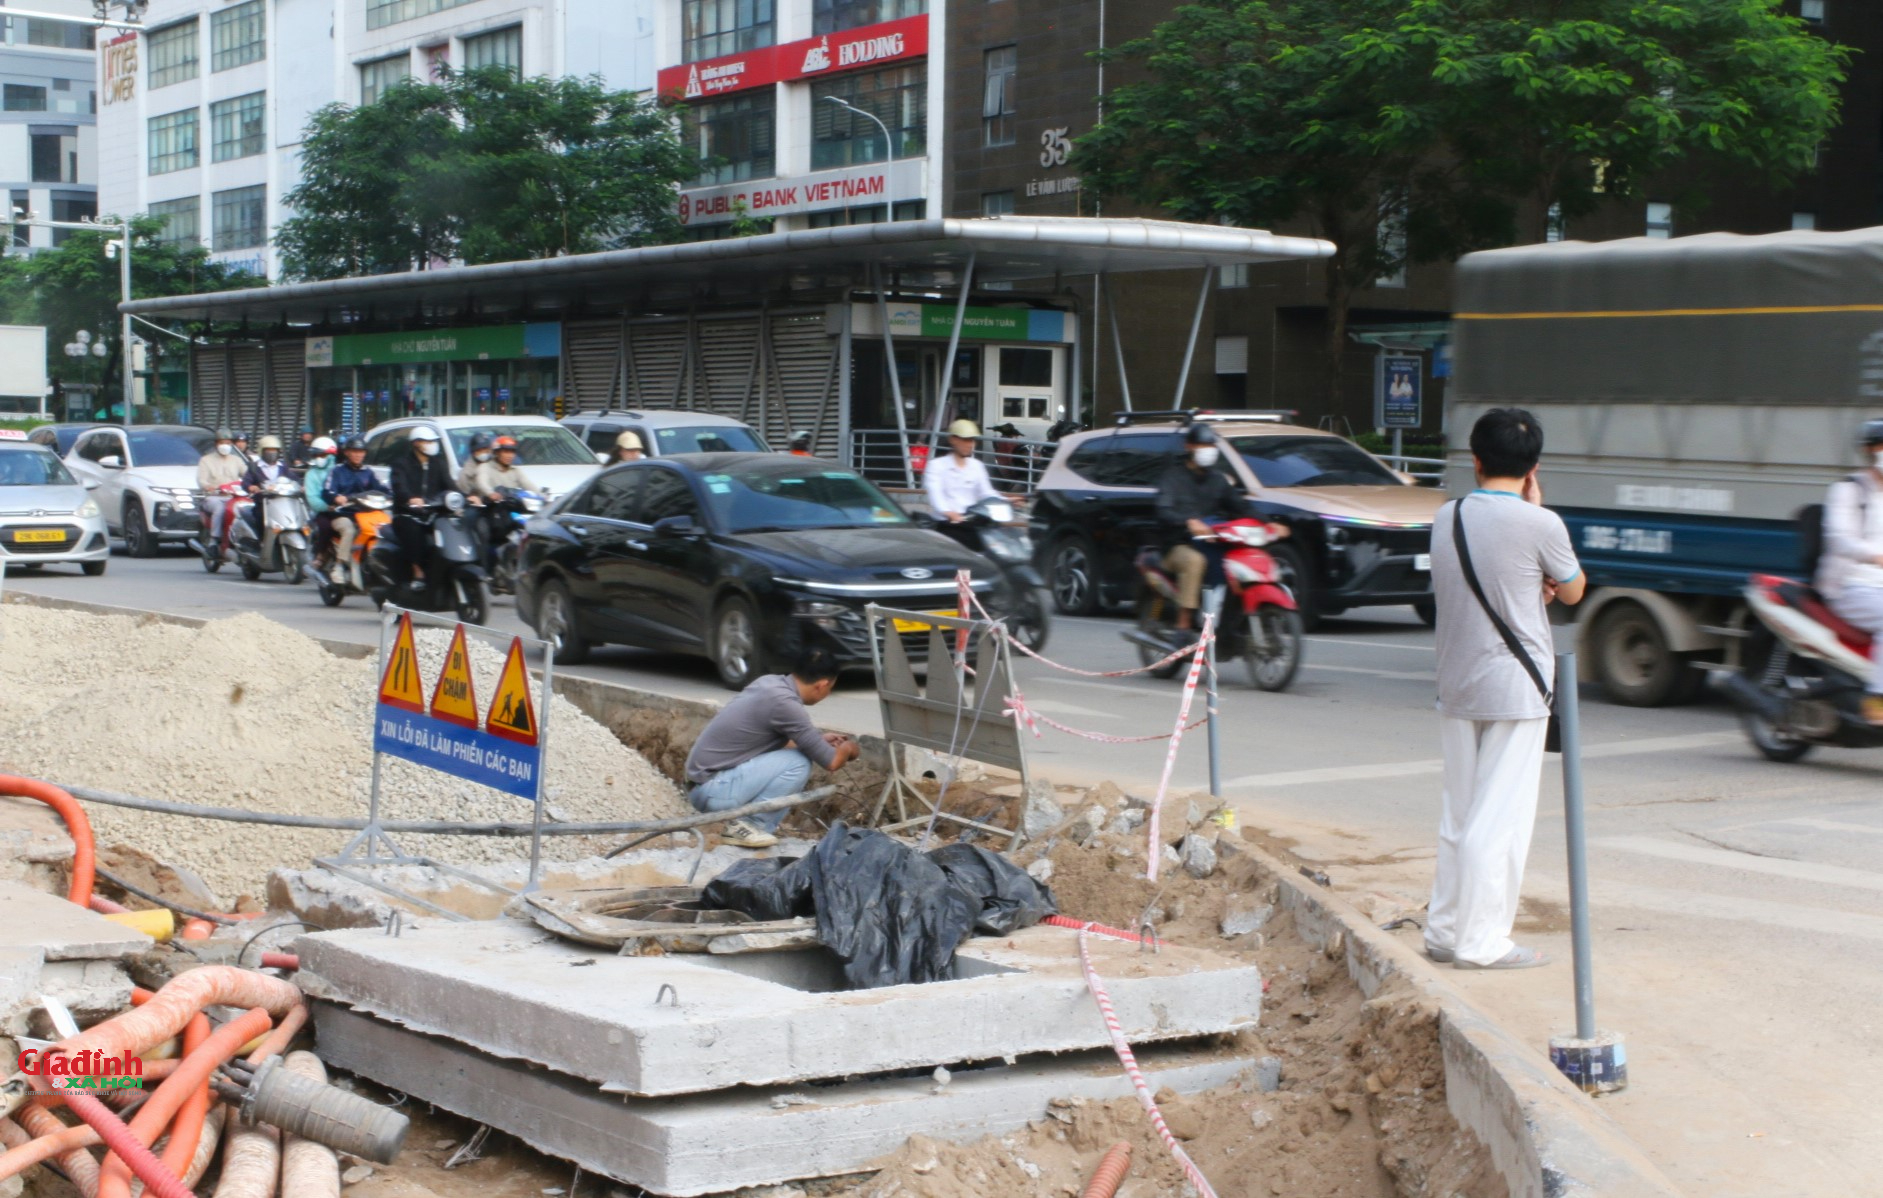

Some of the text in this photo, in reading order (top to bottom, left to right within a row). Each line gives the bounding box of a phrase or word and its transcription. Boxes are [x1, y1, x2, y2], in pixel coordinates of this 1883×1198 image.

[838, 33, 904, 66] HOLDING
[1040, 126, 1072, 168] 35
[753, 186, 797, 209] BANK
[804, 175, 884, 202] VIETNAM
[381, 719, 396, 738] XIN
[398, 719, 414, 744] LỖI
[415, 728, 429, 749] ĐÃ
[430, 732, 451, 756] LÀM
[485, 750, 507, 773] CÁC
[509, 758, 532, 782] BẠN
